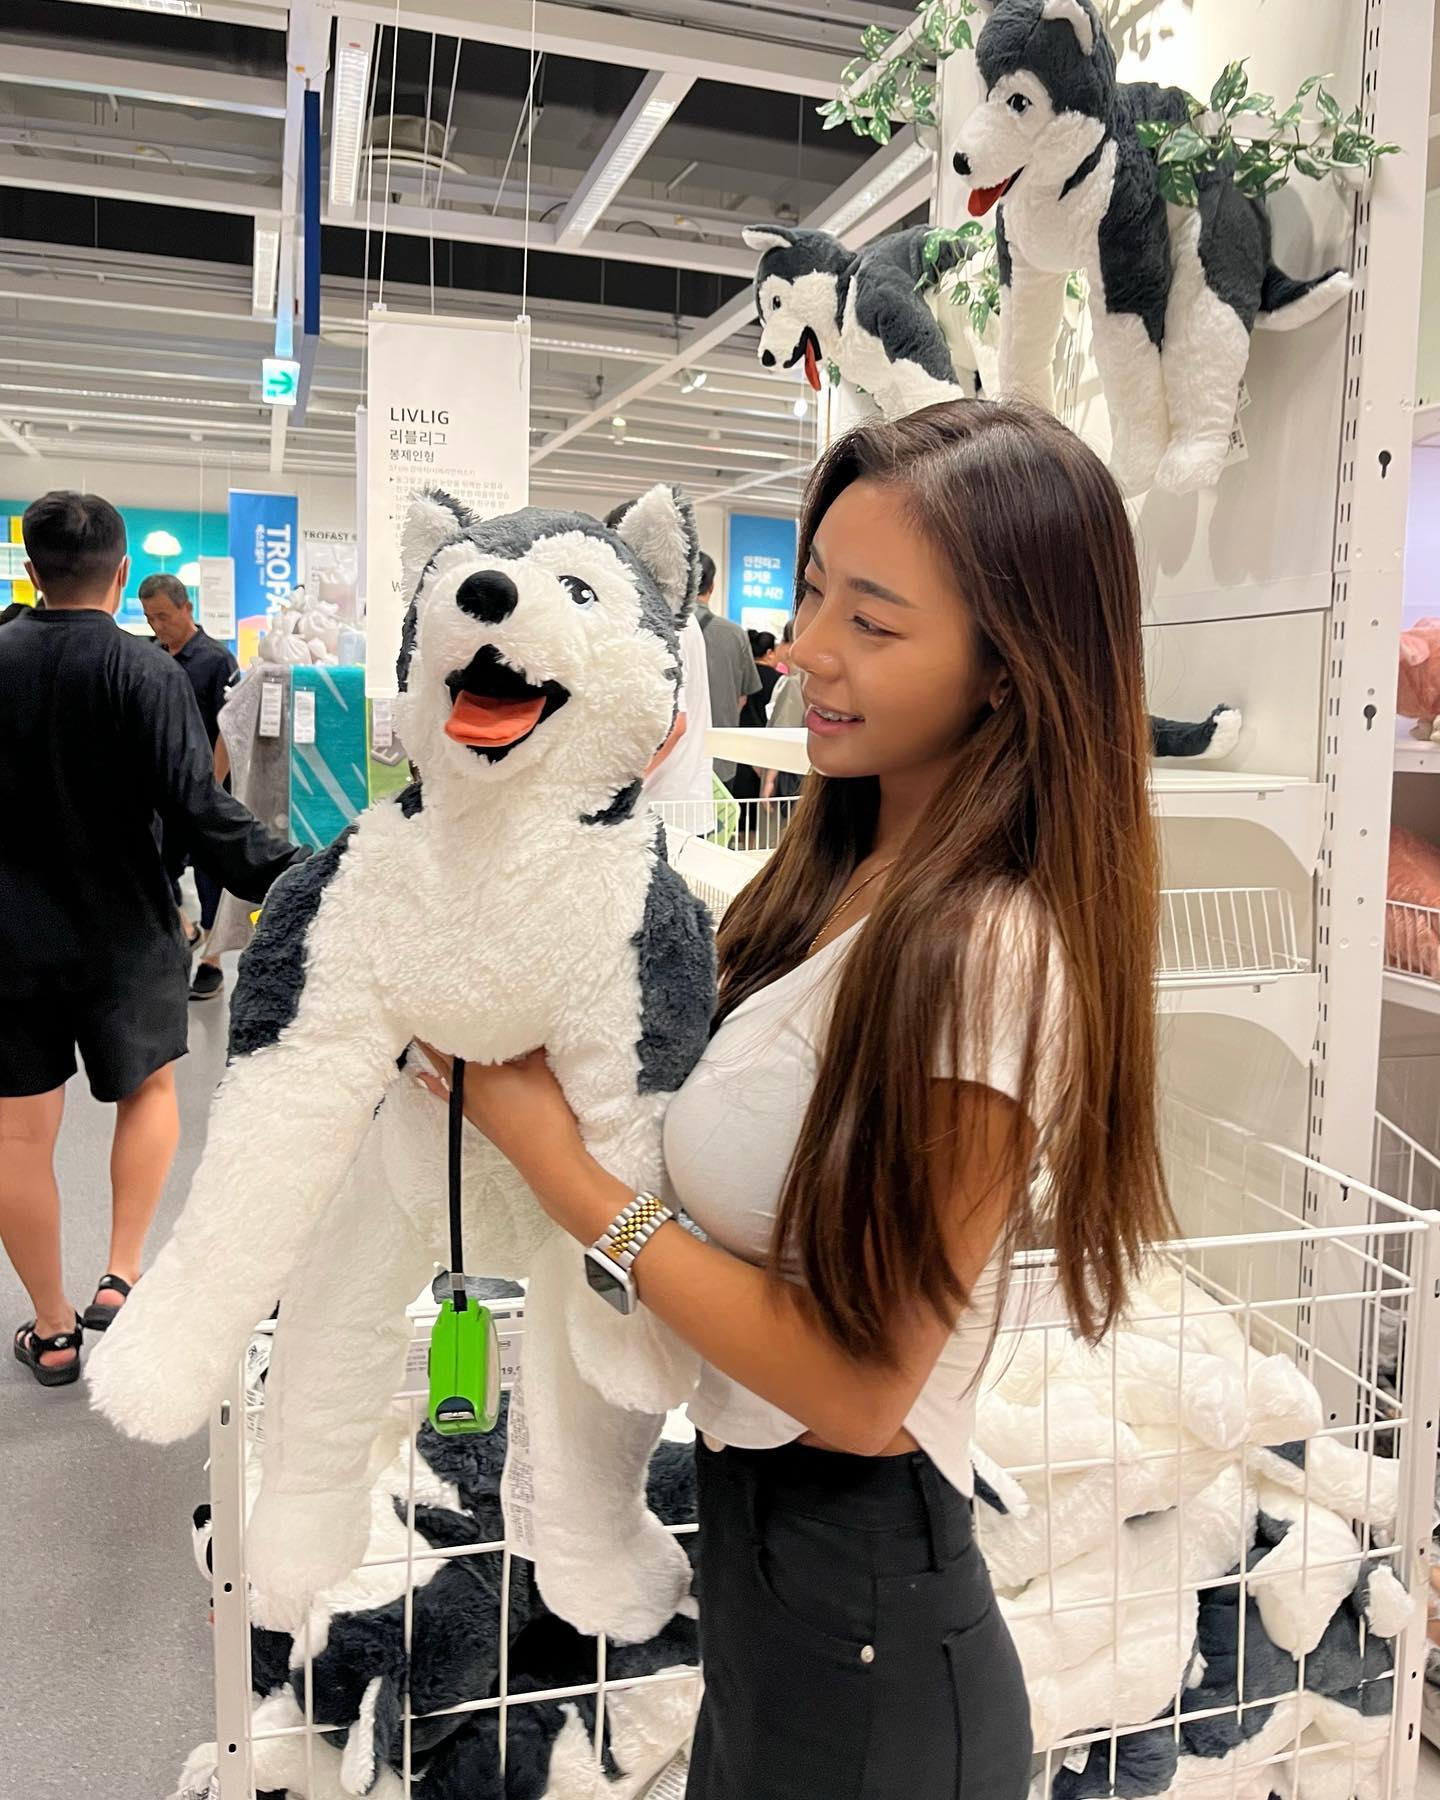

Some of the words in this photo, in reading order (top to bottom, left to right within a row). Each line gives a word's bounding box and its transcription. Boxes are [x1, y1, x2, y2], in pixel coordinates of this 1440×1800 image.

[390, 407, 449, 425] LIVLIG
[389, 429, 448, 446] 리블리그
[389, 449, 434, 463] 봉제인형
[303, 530, 349, 542] TROFAST
